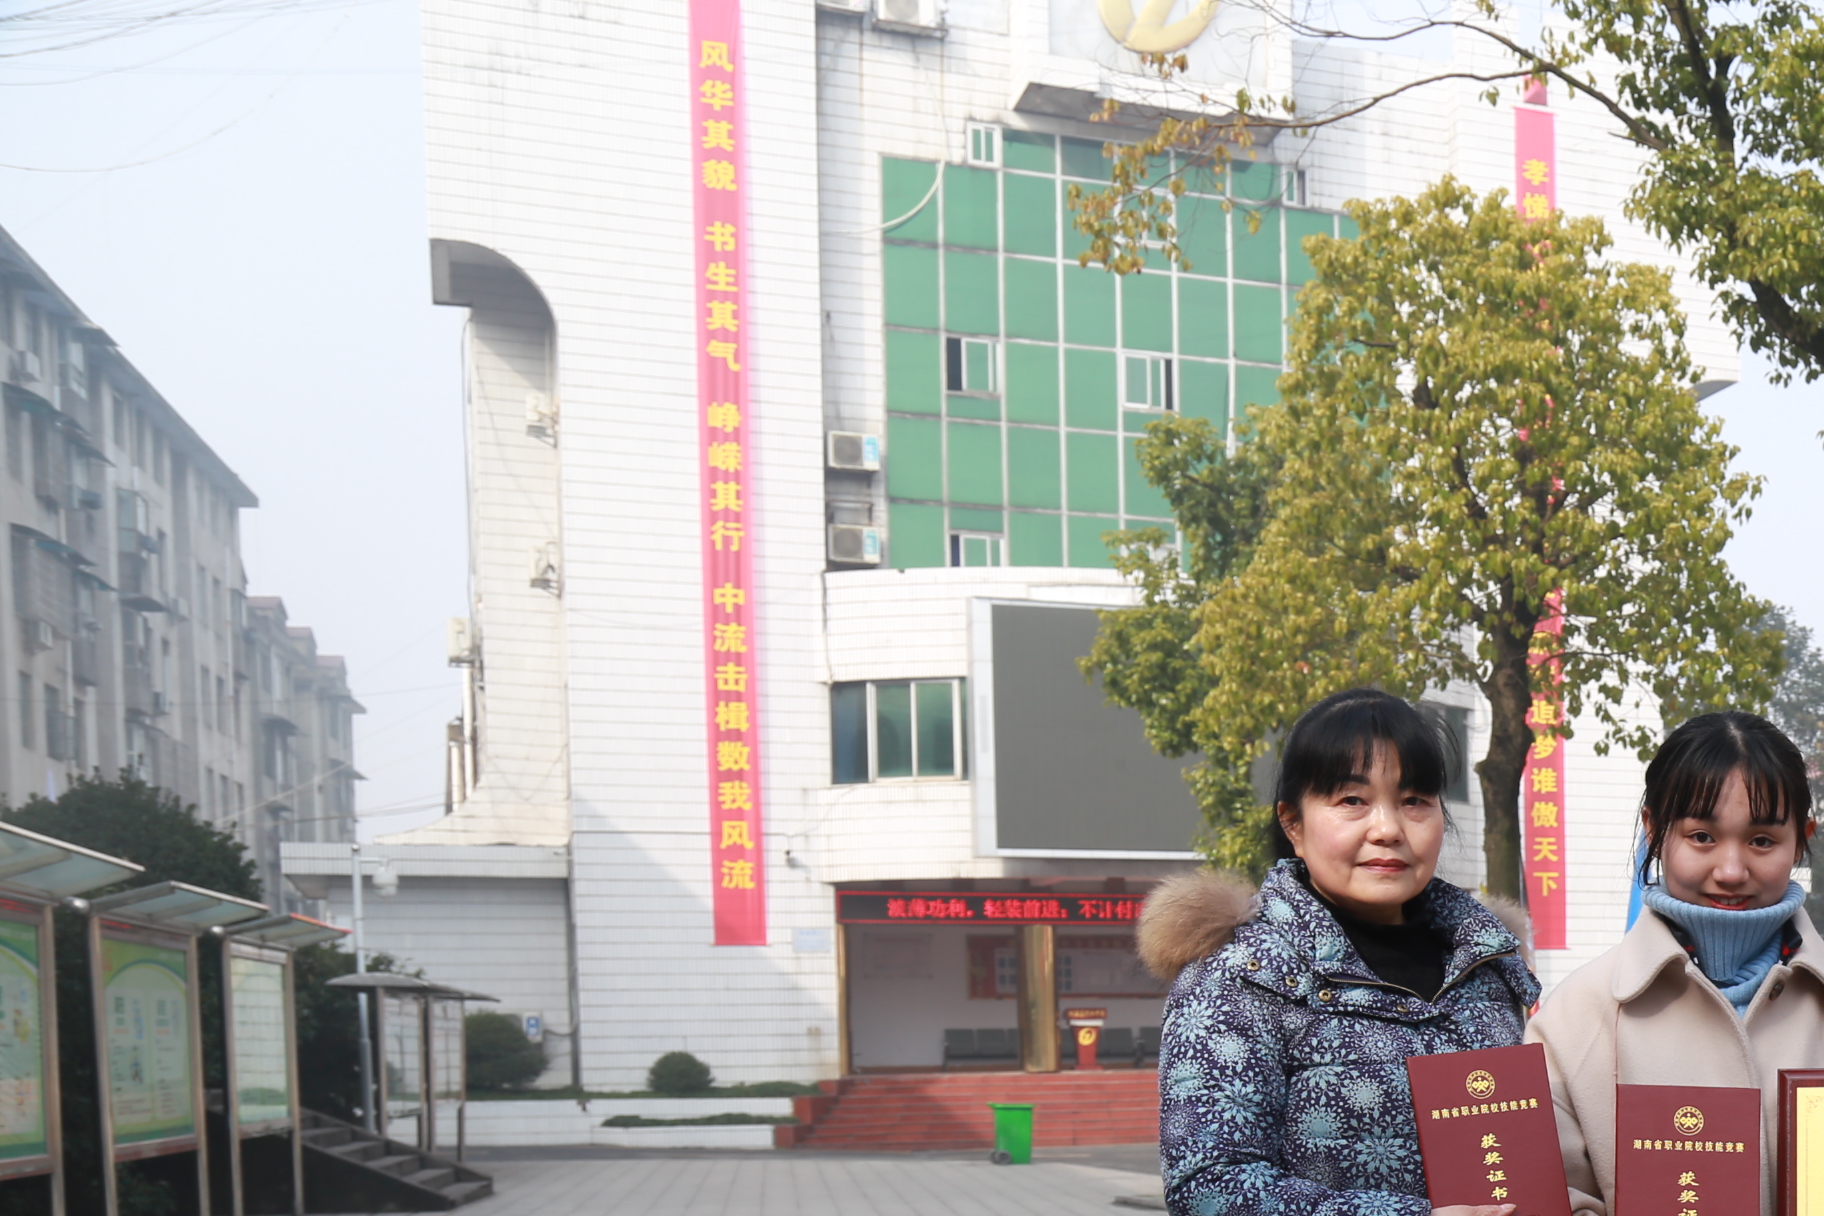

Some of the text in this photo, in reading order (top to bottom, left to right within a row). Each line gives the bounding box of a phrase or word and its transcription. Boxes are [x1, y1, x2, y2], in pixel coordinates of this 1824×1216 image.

[699, 39, 756, 889] 风华其貌 书生其气 峥嵘其行 中流击楫数我风流
[1431, 1097, 1539, 1120] 湖南省职业院校技能竞赛
[1480, 1132, 1509, 1201] 获奖证书
[1633, 1139, 1745, 1153] 湖南省职业院校技能竞赛
